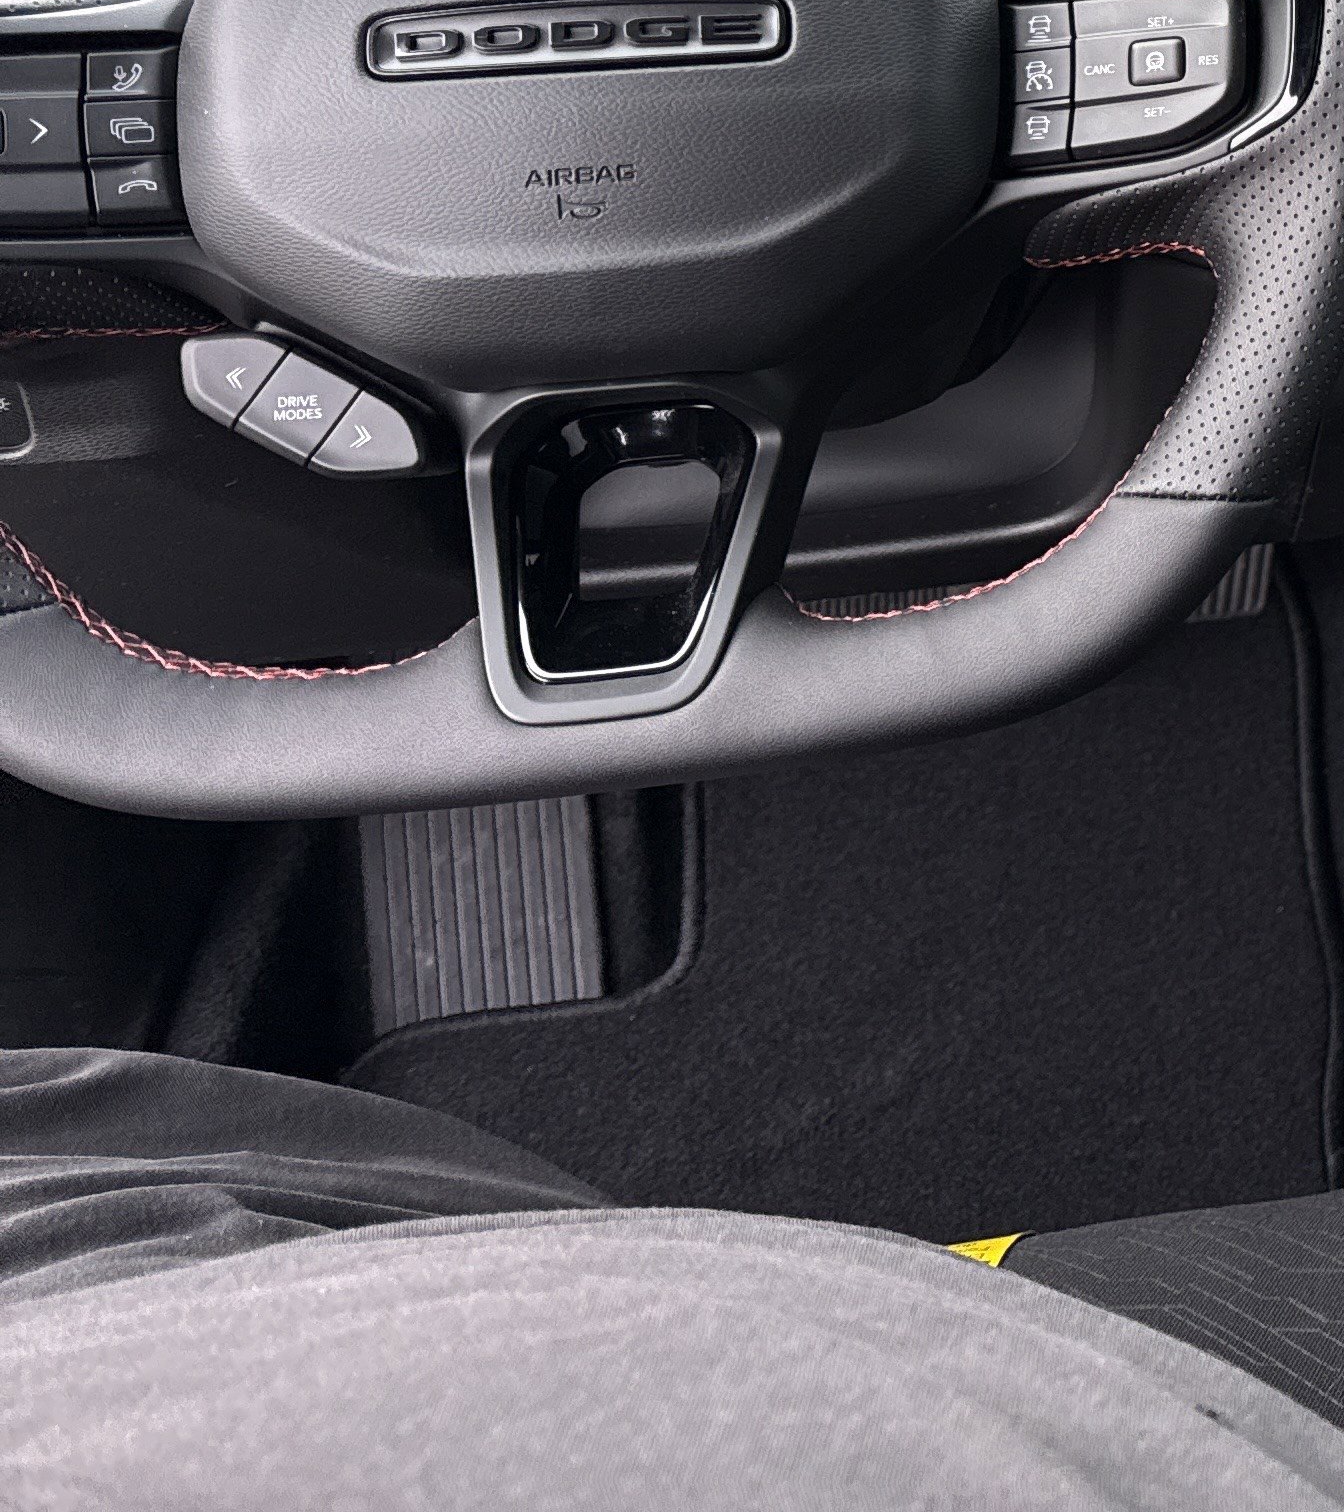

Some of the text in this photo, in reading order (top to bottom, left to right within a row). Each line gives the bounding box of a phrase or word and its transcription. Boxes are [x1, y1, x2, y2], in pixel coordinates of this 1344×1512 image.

[394, 14, 764, 62] DODGE
[1198, 55, 1219, 66] RES
[1084, 63, 1116, 76] CANC
[525, 162, 639, 189] AIRBAG
[277, 394, 319, 408] DRIVE
[273, 407, 323, 421] MODES
